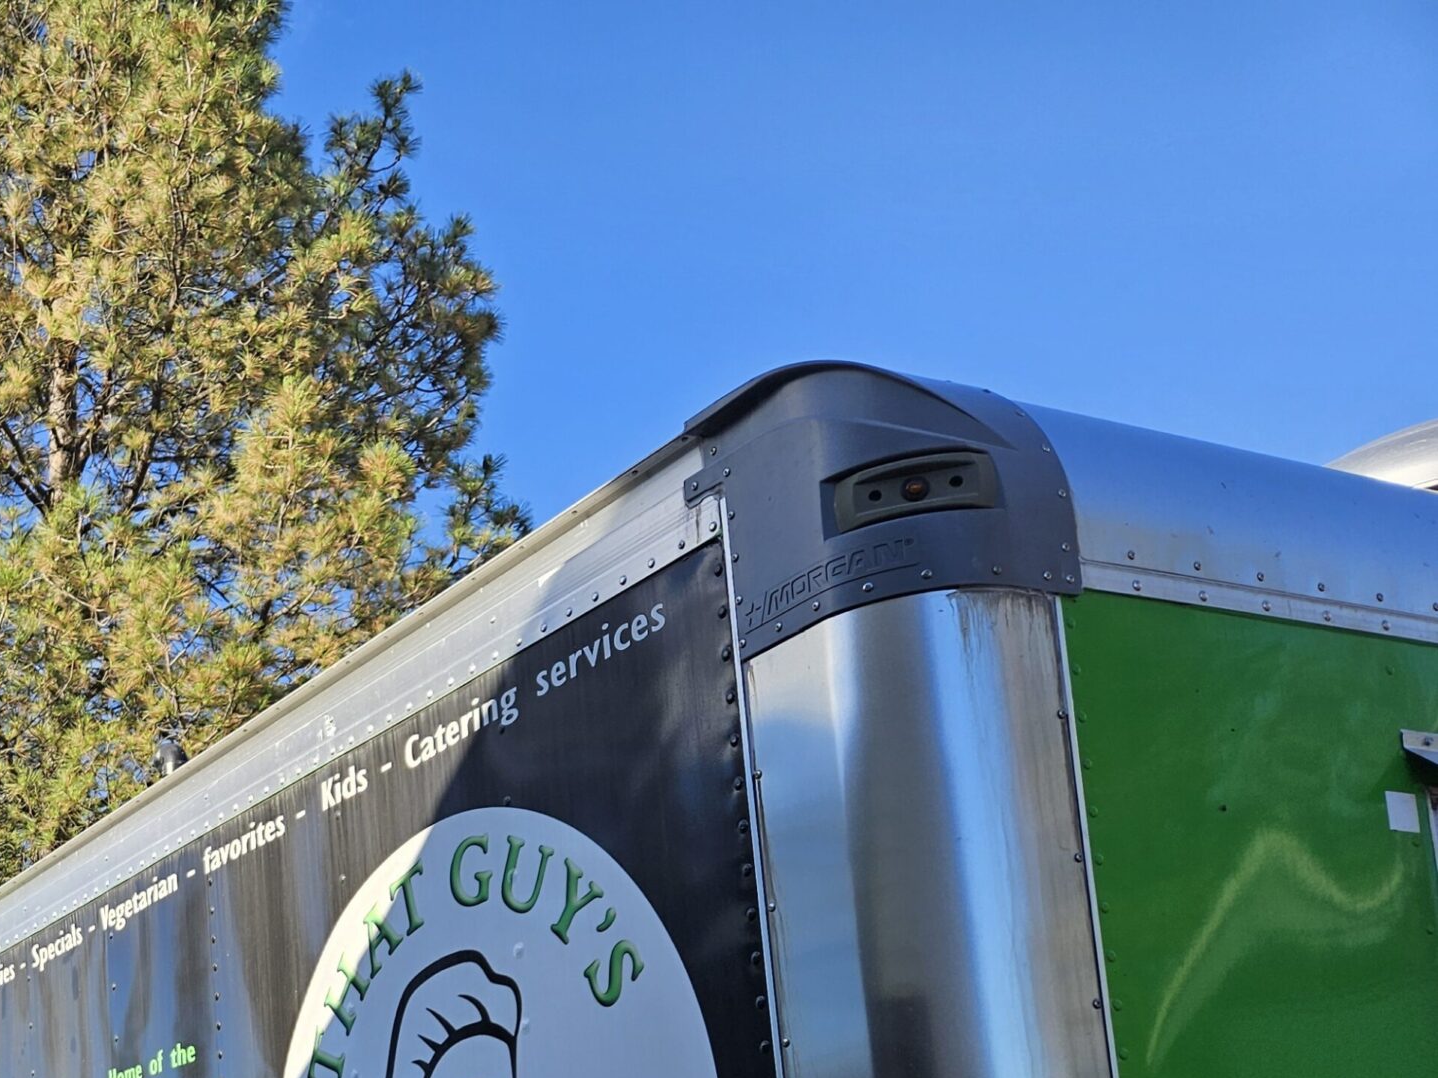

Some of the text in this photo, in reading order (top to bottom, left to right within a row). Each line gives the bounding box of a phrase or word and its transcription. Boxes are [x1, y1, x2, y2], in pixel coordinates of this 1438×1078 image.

[32, 923, 83, 971] Specials
[100, 873, 178, 931] Vegetarian
[203, 815, 285, 875] favorites
[321, 767, 368, 812] Kids
[404, 686, 519, 769] Catering
[536, 602, 666, 697] services
[449, 833, 645, 1008] GUY'S
[149, 1049, 164, 1075] of
[170, 1042, 196, 1069] the
